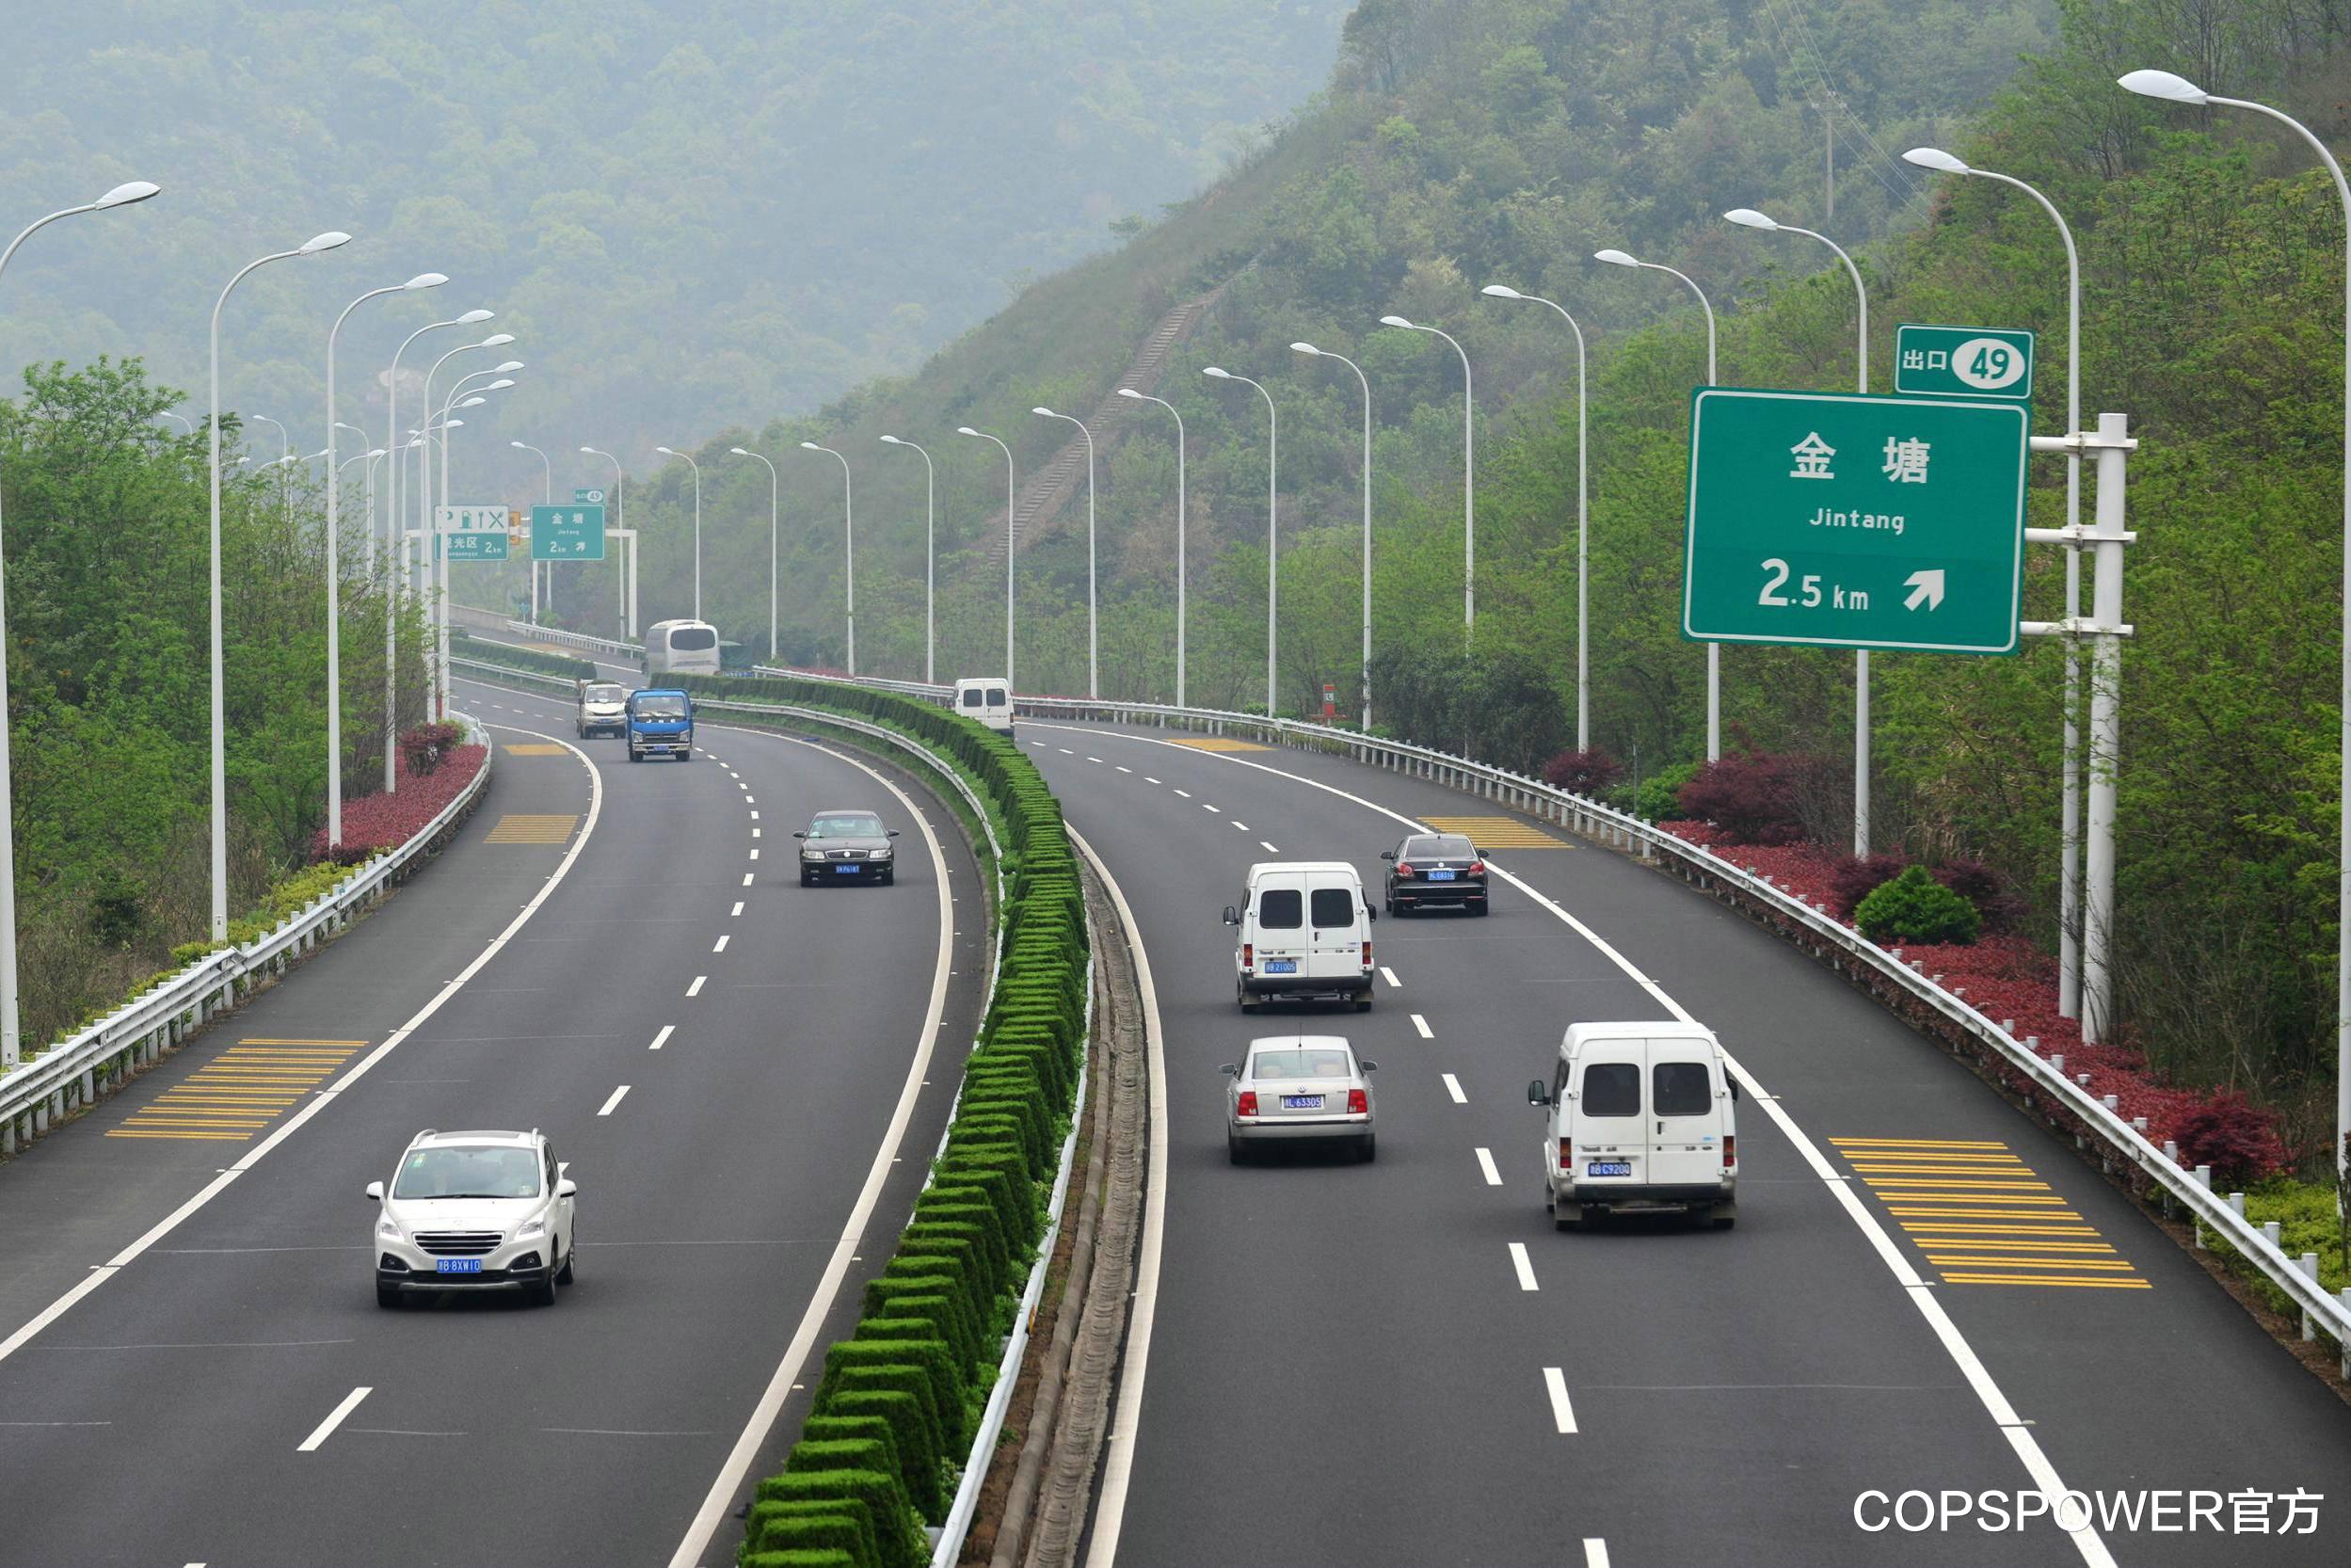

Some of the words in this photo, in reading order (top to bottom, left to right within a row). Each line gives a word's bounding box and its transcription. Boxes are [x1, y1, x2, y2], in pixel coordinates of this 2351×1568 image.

[1902, 349, 1947, 371] 出口
[1969, 346, 2010, 379] 49
[1809, 508, 1905, 536] Jintang
[1758, 558, 1822, 607] 2.5
[1832, 584, 1869, 611] km
